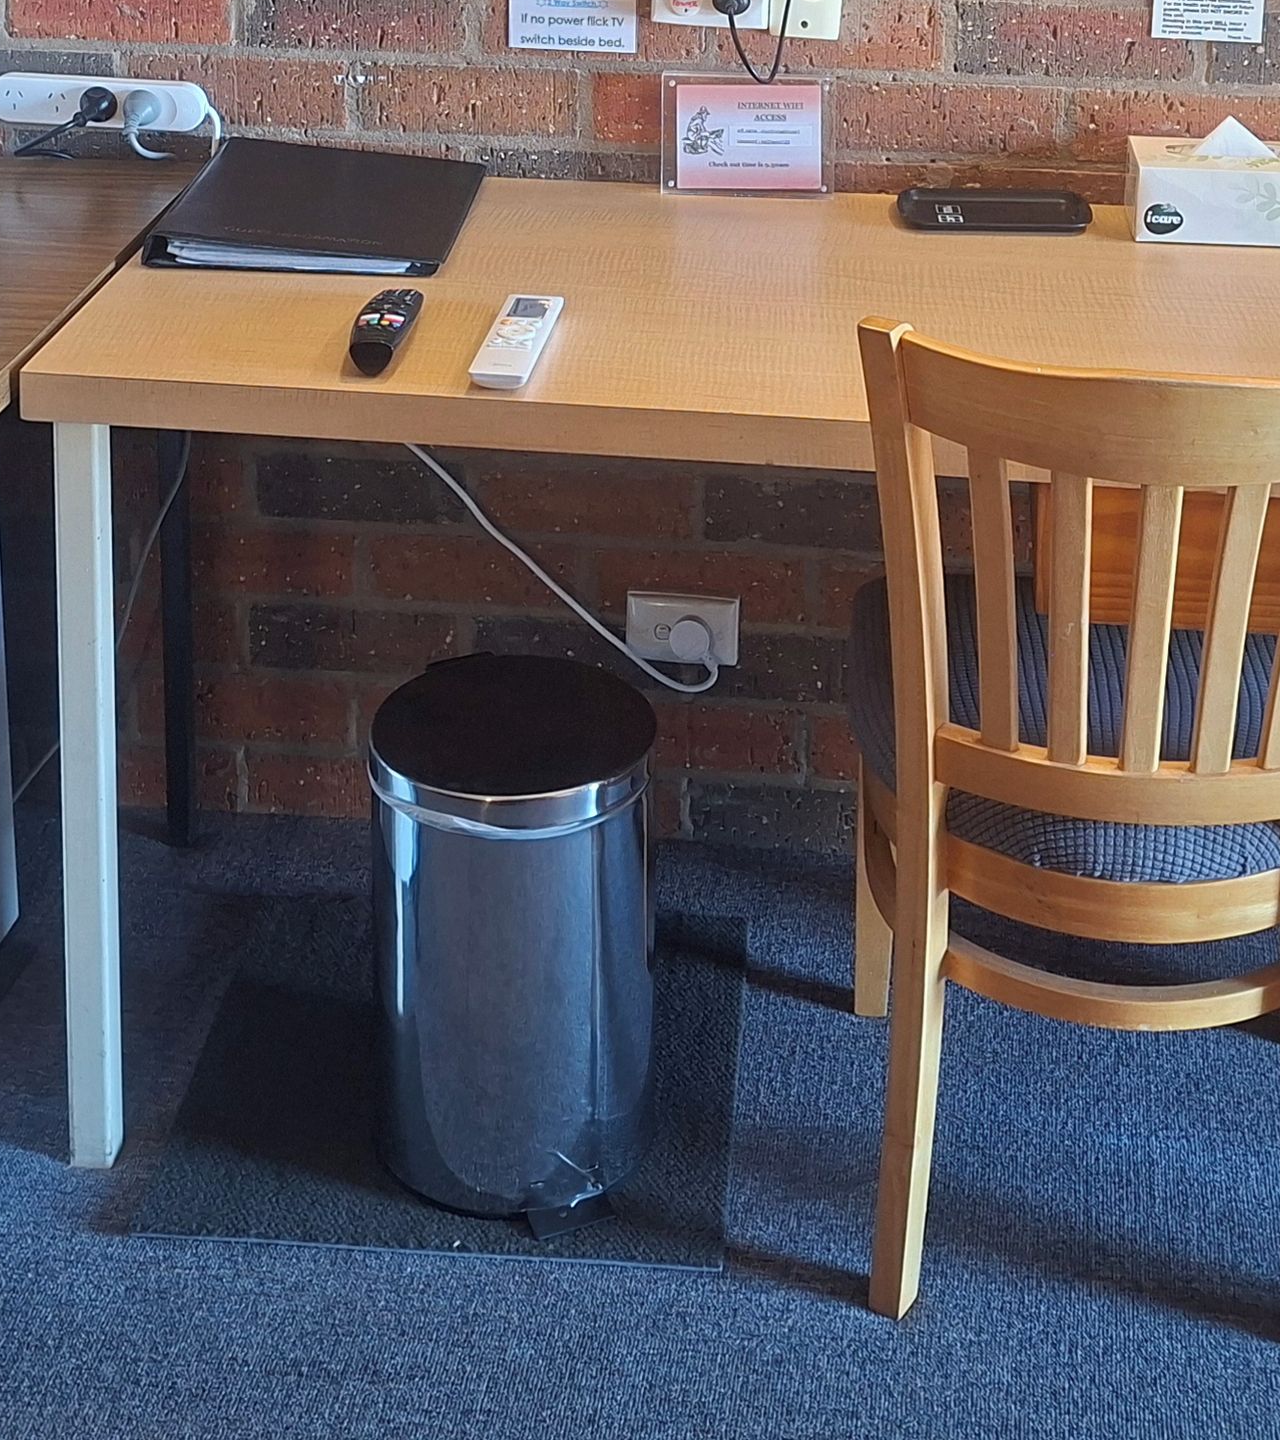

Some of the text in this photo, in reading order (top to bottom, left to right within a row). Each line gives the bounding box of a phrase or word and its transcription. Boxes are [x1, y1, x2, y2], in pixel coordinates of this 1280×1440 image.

[572, 0, 597, 8] Switch
[521, 13, 624, 27] If no power flick TV
[520, 34, 624, 48] switch beside bed.
[737, 102, 781, 110] INTERNET
[754, 114, 787, 122] ACCESS
